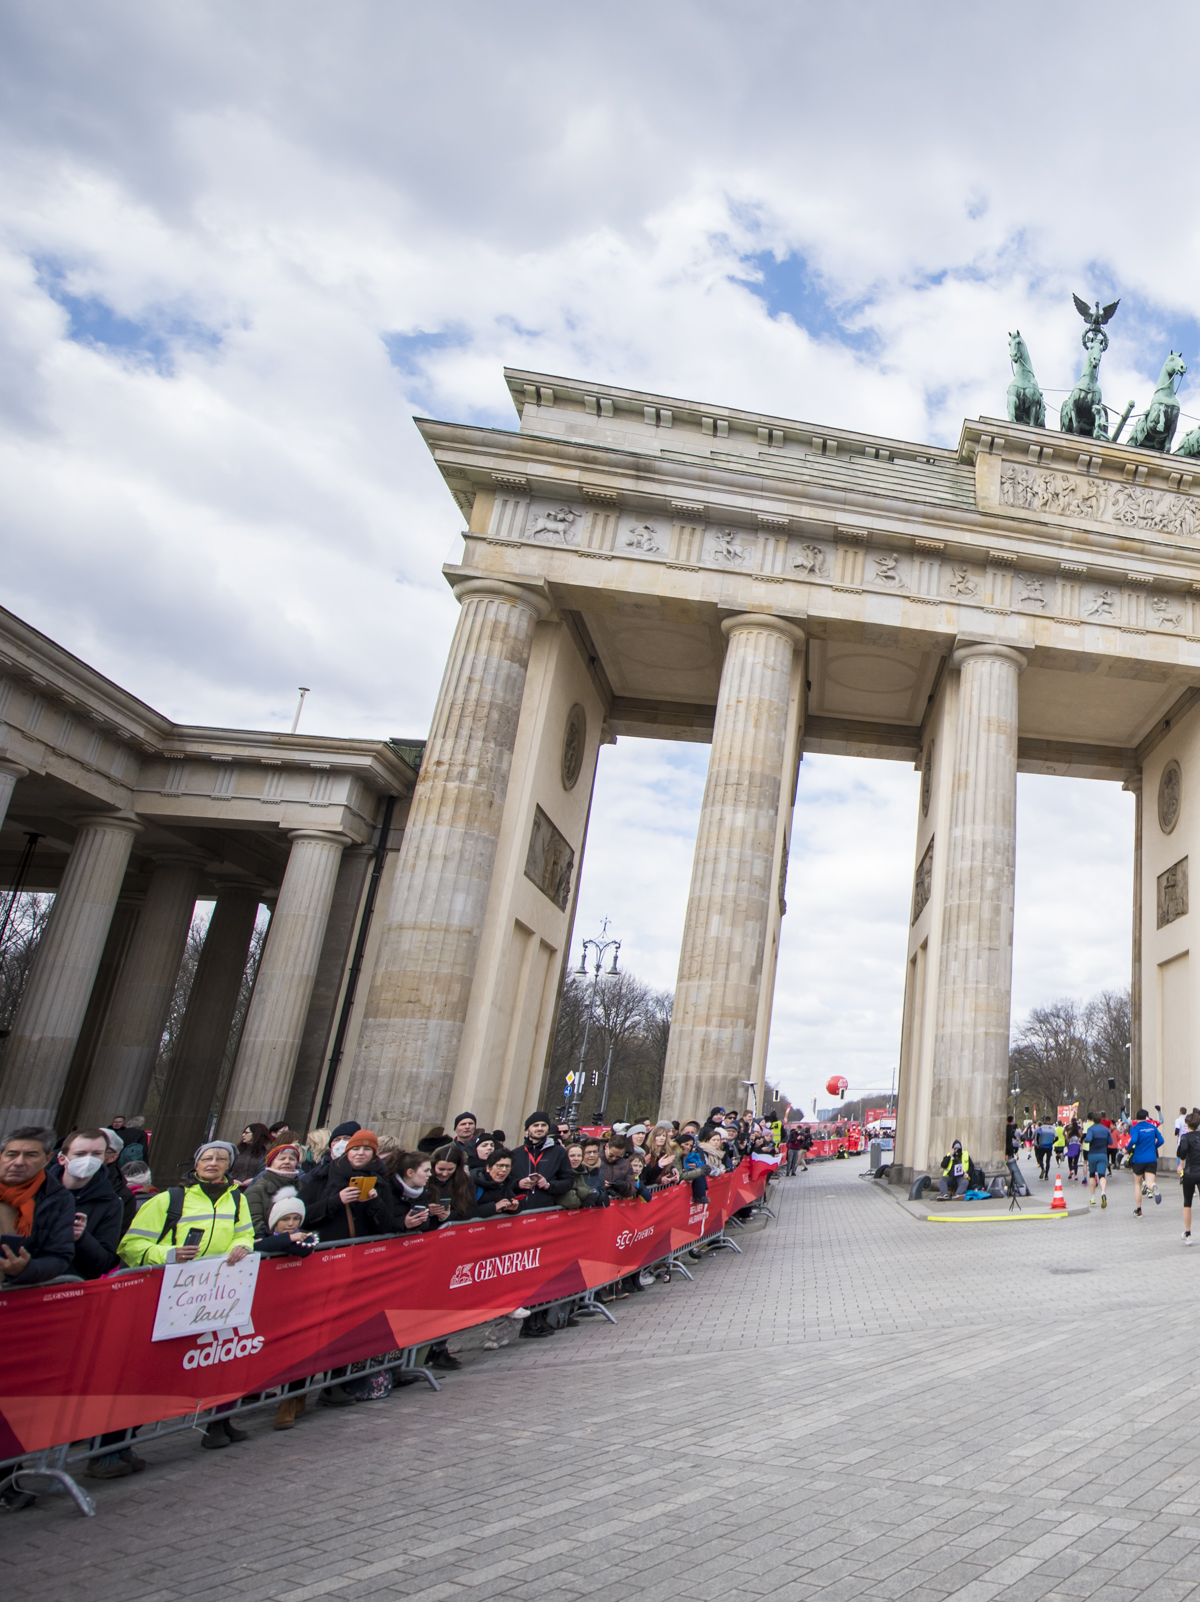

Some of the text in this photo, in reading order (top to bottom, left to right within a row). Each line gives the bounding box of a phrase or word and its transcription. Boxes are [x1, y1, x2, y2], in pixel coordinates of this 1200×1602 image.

[616, 1225, 655, 1249] SCC EVENTS
[173, 1261, 227, 1288] Lauf
[474, 1247, 541, 1282] GENERALI
[176, 1285, 237, 1307] Camillo
[183, 1336, 265, 1370] adidas
